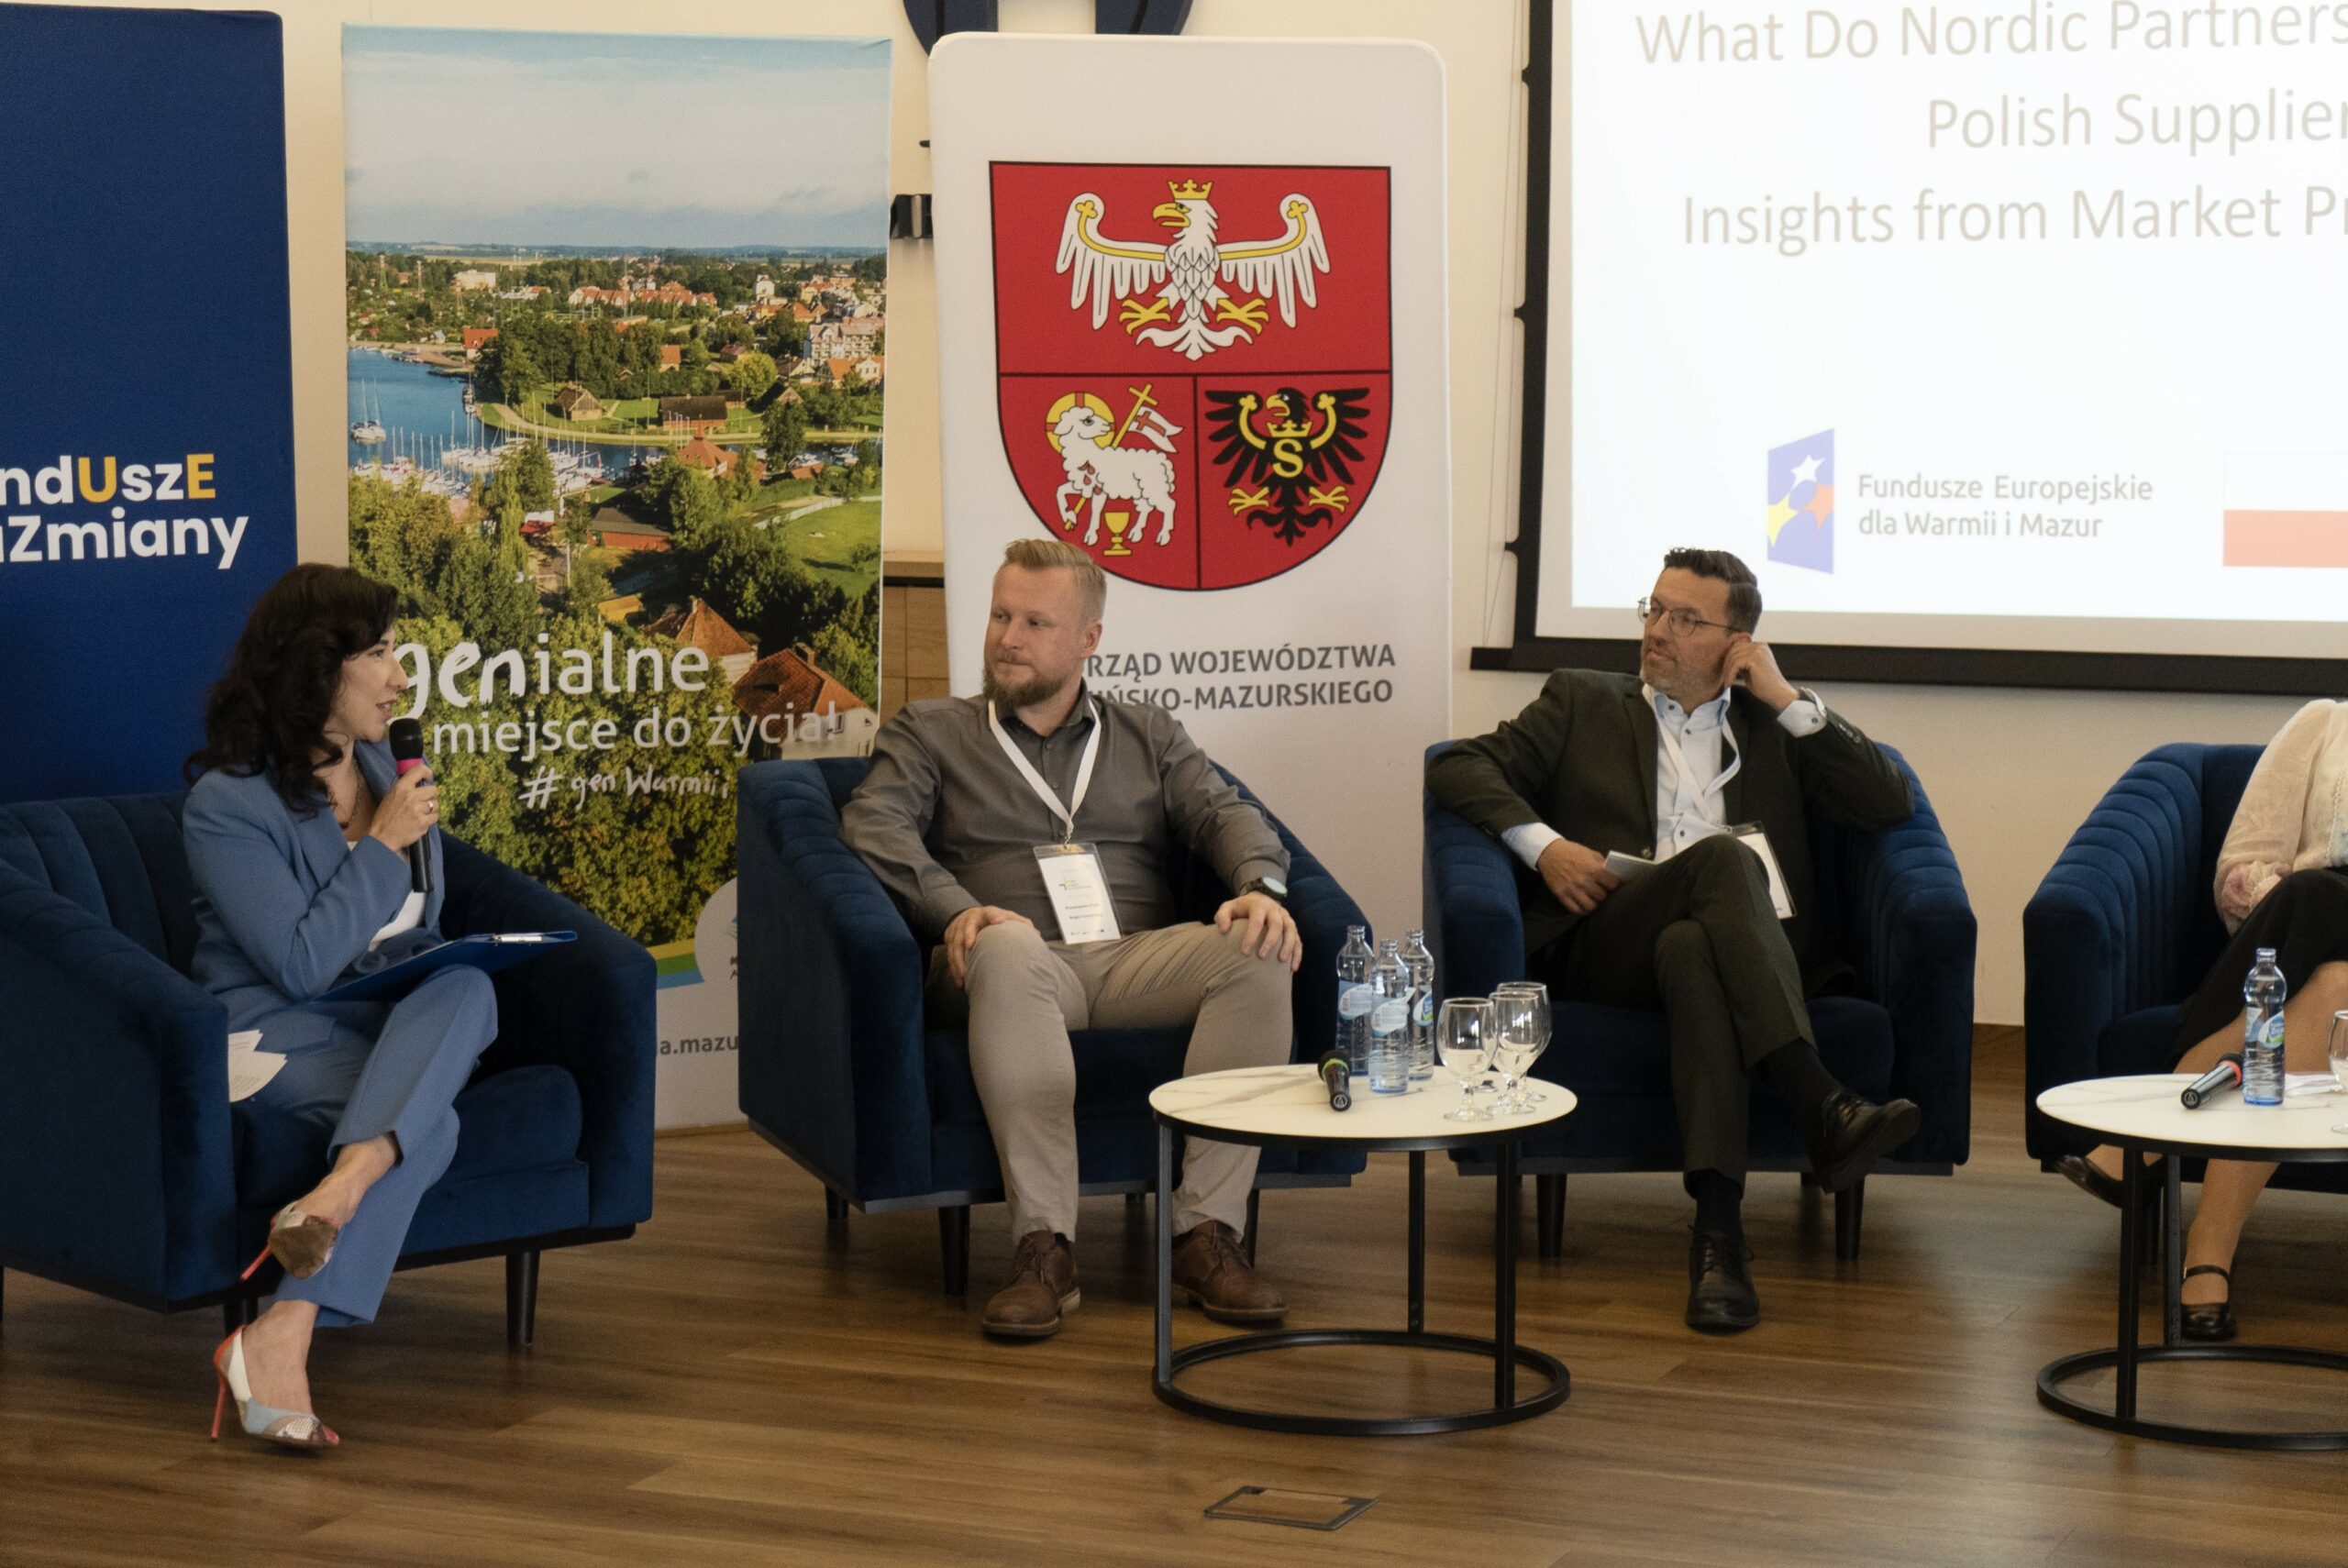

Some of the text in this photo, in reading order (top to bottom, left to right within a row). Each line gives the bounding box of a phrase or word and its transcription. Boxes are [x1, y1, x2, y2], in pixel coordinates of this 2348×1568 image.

[1635, 0, 2348, 63] What Do Nordic Partners
[1929, 93, 2091, 148] Polish
[1685, 185, 2348, 257] Insights from Market P
[1272, 438, 1303, 478] S
[1858, 472, 2154, 504] Fundusze Europejskie
[0, 506, 249, 570] Zmiany
[1858, 509, 2103, 537] dla Warmii i Mazur
[386, 632, 710, 724] genialne
[1170, 643, 1397, 675] WOJEWÓDZTWA
[1088, 679, 1394, 712] ŃSKO-MAZURSKIEGO
[434, 700, 836, 762] miejsce do życia!
